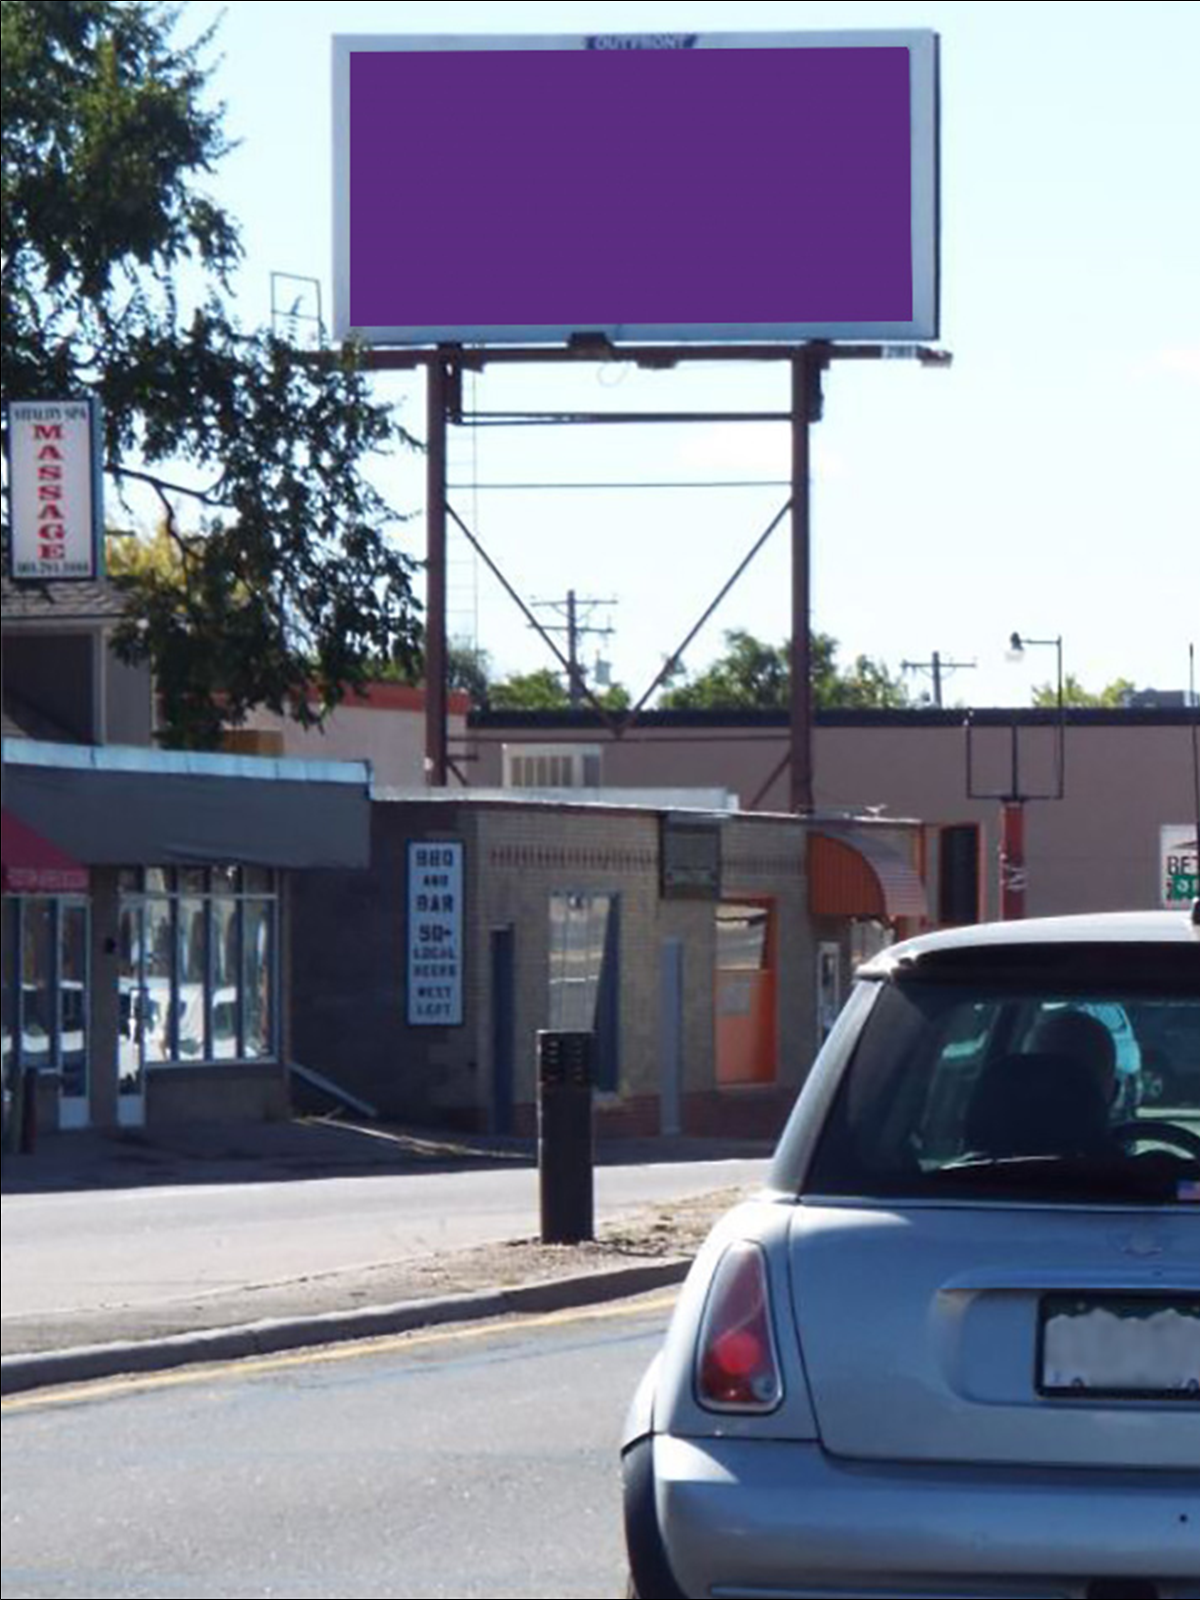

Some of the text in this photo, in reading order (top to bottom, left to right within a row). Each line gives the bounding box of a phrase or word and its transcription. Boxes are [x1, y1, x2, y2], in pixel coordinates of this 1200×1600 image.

[34, 424, 65, 560] MASSAGE
[416, 894, 454, 913] BAR
[414, 946, 456, 959] LOCAL
